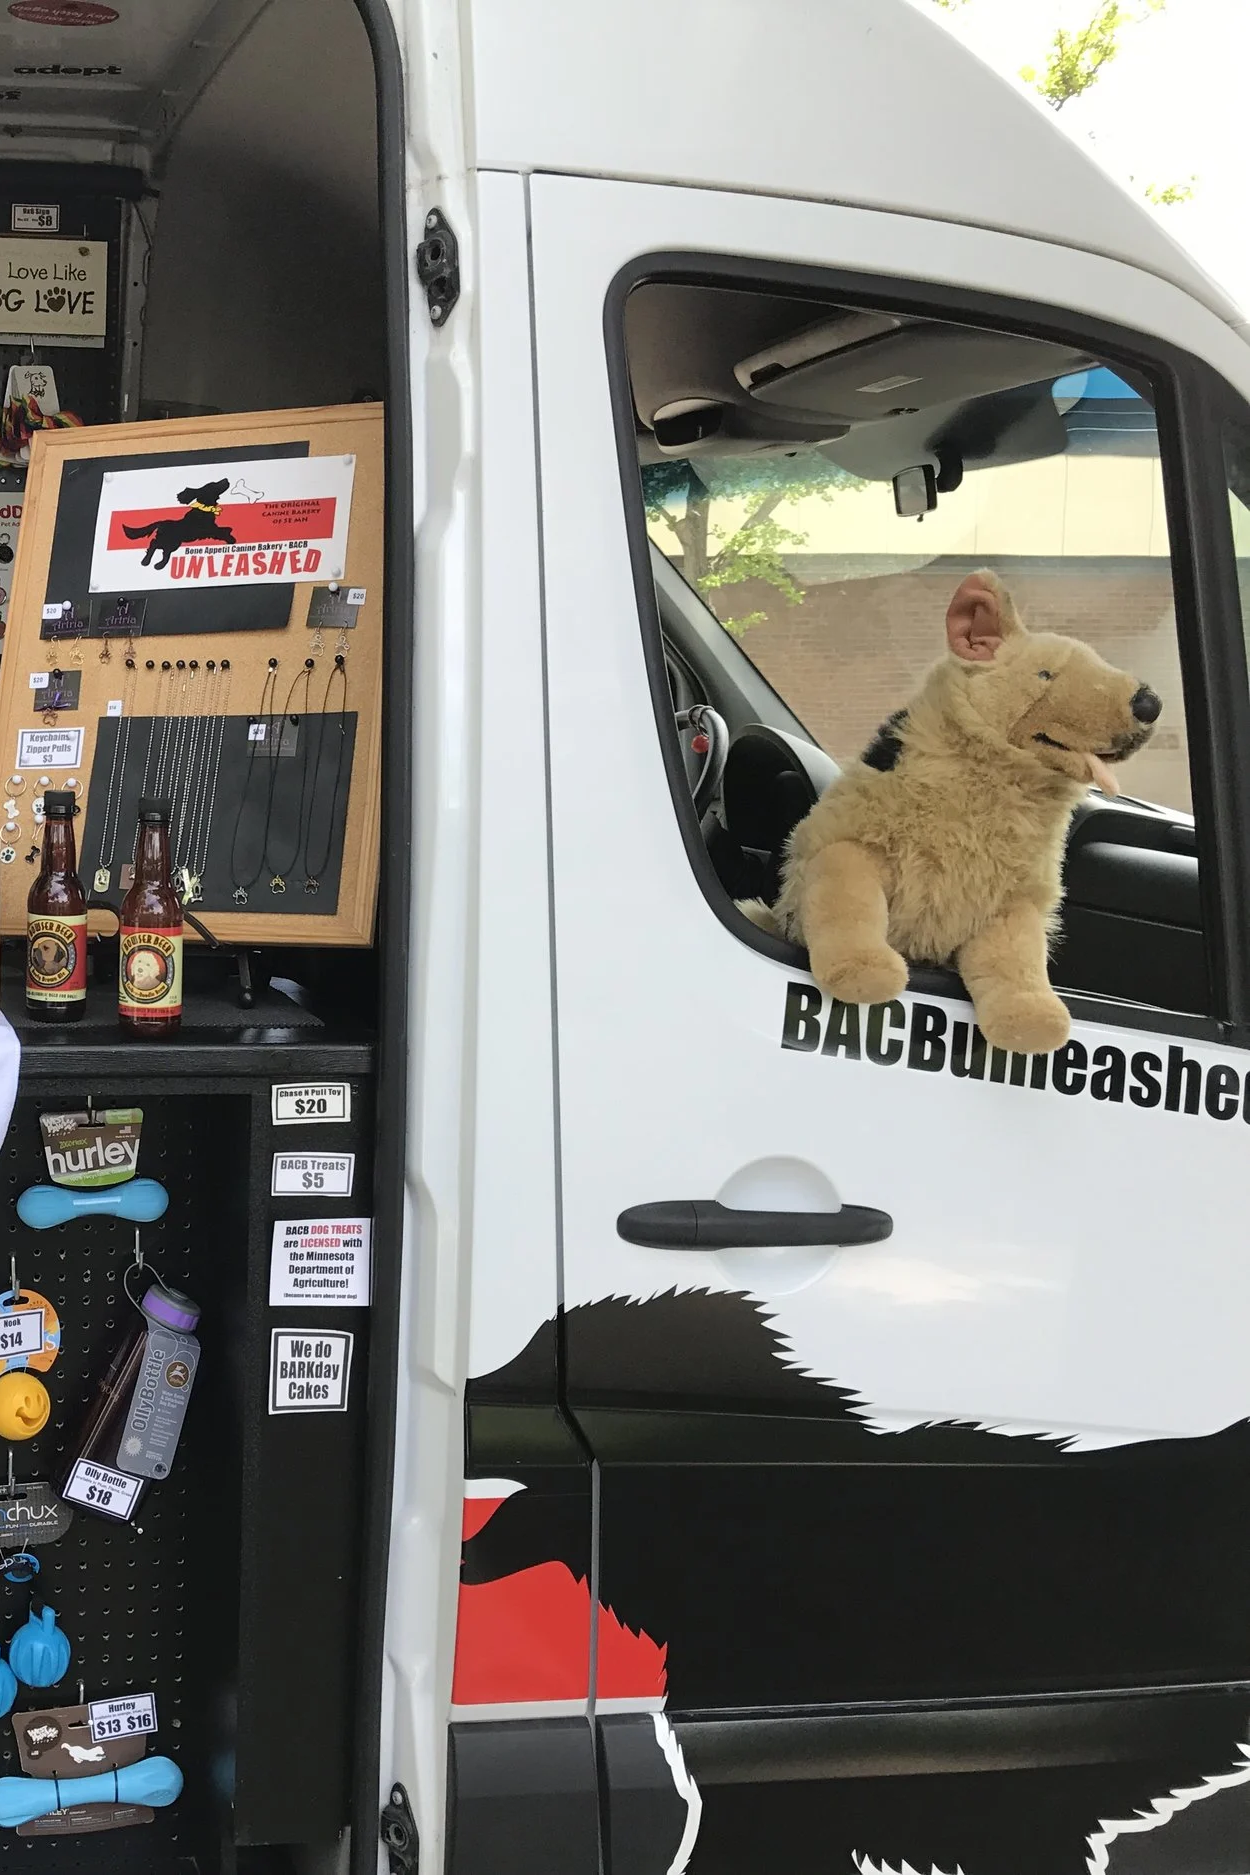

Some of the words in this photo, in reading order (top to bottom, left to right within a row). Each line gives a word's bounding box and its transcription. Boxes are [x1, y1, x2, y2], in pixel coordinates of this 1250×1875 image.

[13, 65, 122, 76] adopt
[38, 215, 52, 227] $8
[8, 262, 48, 281] Love
[53, 262, 87, 282] Like
[34, 286, 95, 314] LOVE
[280, 500, 320, 508] ORIGINAL
[185, 547, 203, 555] Bone
[204, 545, 230, 556] Appetit
[231, 544, 256, 553] Canine
[257, 542, 283, 553] Bakery
[288, 541, 308, 549] BACB
[170, 549, 321, 580] UNLEASHED
[30, 733, 70, 743] Keychains
[26, 744, 50, 755] Zipper
[52, 744, 71, 753] Pulls
[43, 754, 53, 764] $3
[55, 924, 74, 940] BEER
[123, 934, 152, 951] BOWSER
[153, 936, 172, 954] BEER
[279, 1089, 302, 1098] Chase
[304, 1088, 309, 1096] N
[311, 1088, 327, 1096] Pull
[328, 1088, 341, 1098] Toy
[295, 1098, 327, 1116] $20
[45, 1137, 139, 1176] hurley
[280, 1159, 309, 1171] BACB
[310, 1160, 347, 1172] Treats
[301, 1171, 325, 1190] $5
[285, 1225, 309, 1236] BACB
[310, 1225, 329, 1236] DOG
[331, 1224, 362, 1235] TREATS
[283, 1239, 299, 1248] are
[300, 1237, 340, 1248] LICENSED
[342, 1237, 363, 1247] with
[289, 1251, 304, 1261] the
[306, 1250, 354, 1262] Minnesota
[288, 1264, 343, 1276] Department
[345, 1264, 354, 1274] of
[293, 1277, 349, 1289] Agriculture!
[3, 1318, 21, 1328] Nook
[0, 1331, 23, 1350] $14
[290, 1340, 311, 1358] We
[313, 1340, 332, 1358] do
[280, 1360, 339, 1380] BARKday
[130, 1349, 166, 1433] OllyBottle
[288, 1381, 329, 1400] Cakes
[85, 1467, 101, 1481] Olly
[101, 1472, 127, 1489] Bottle
[86, 1485, 112, 1506] $18
[29, 1520, 59, 1528] DURABLE
[108, 1701, 136, 1713] Hurley
[96, 1718, 121, 1736] $13
[126, 1713, 151, 1731] $16
